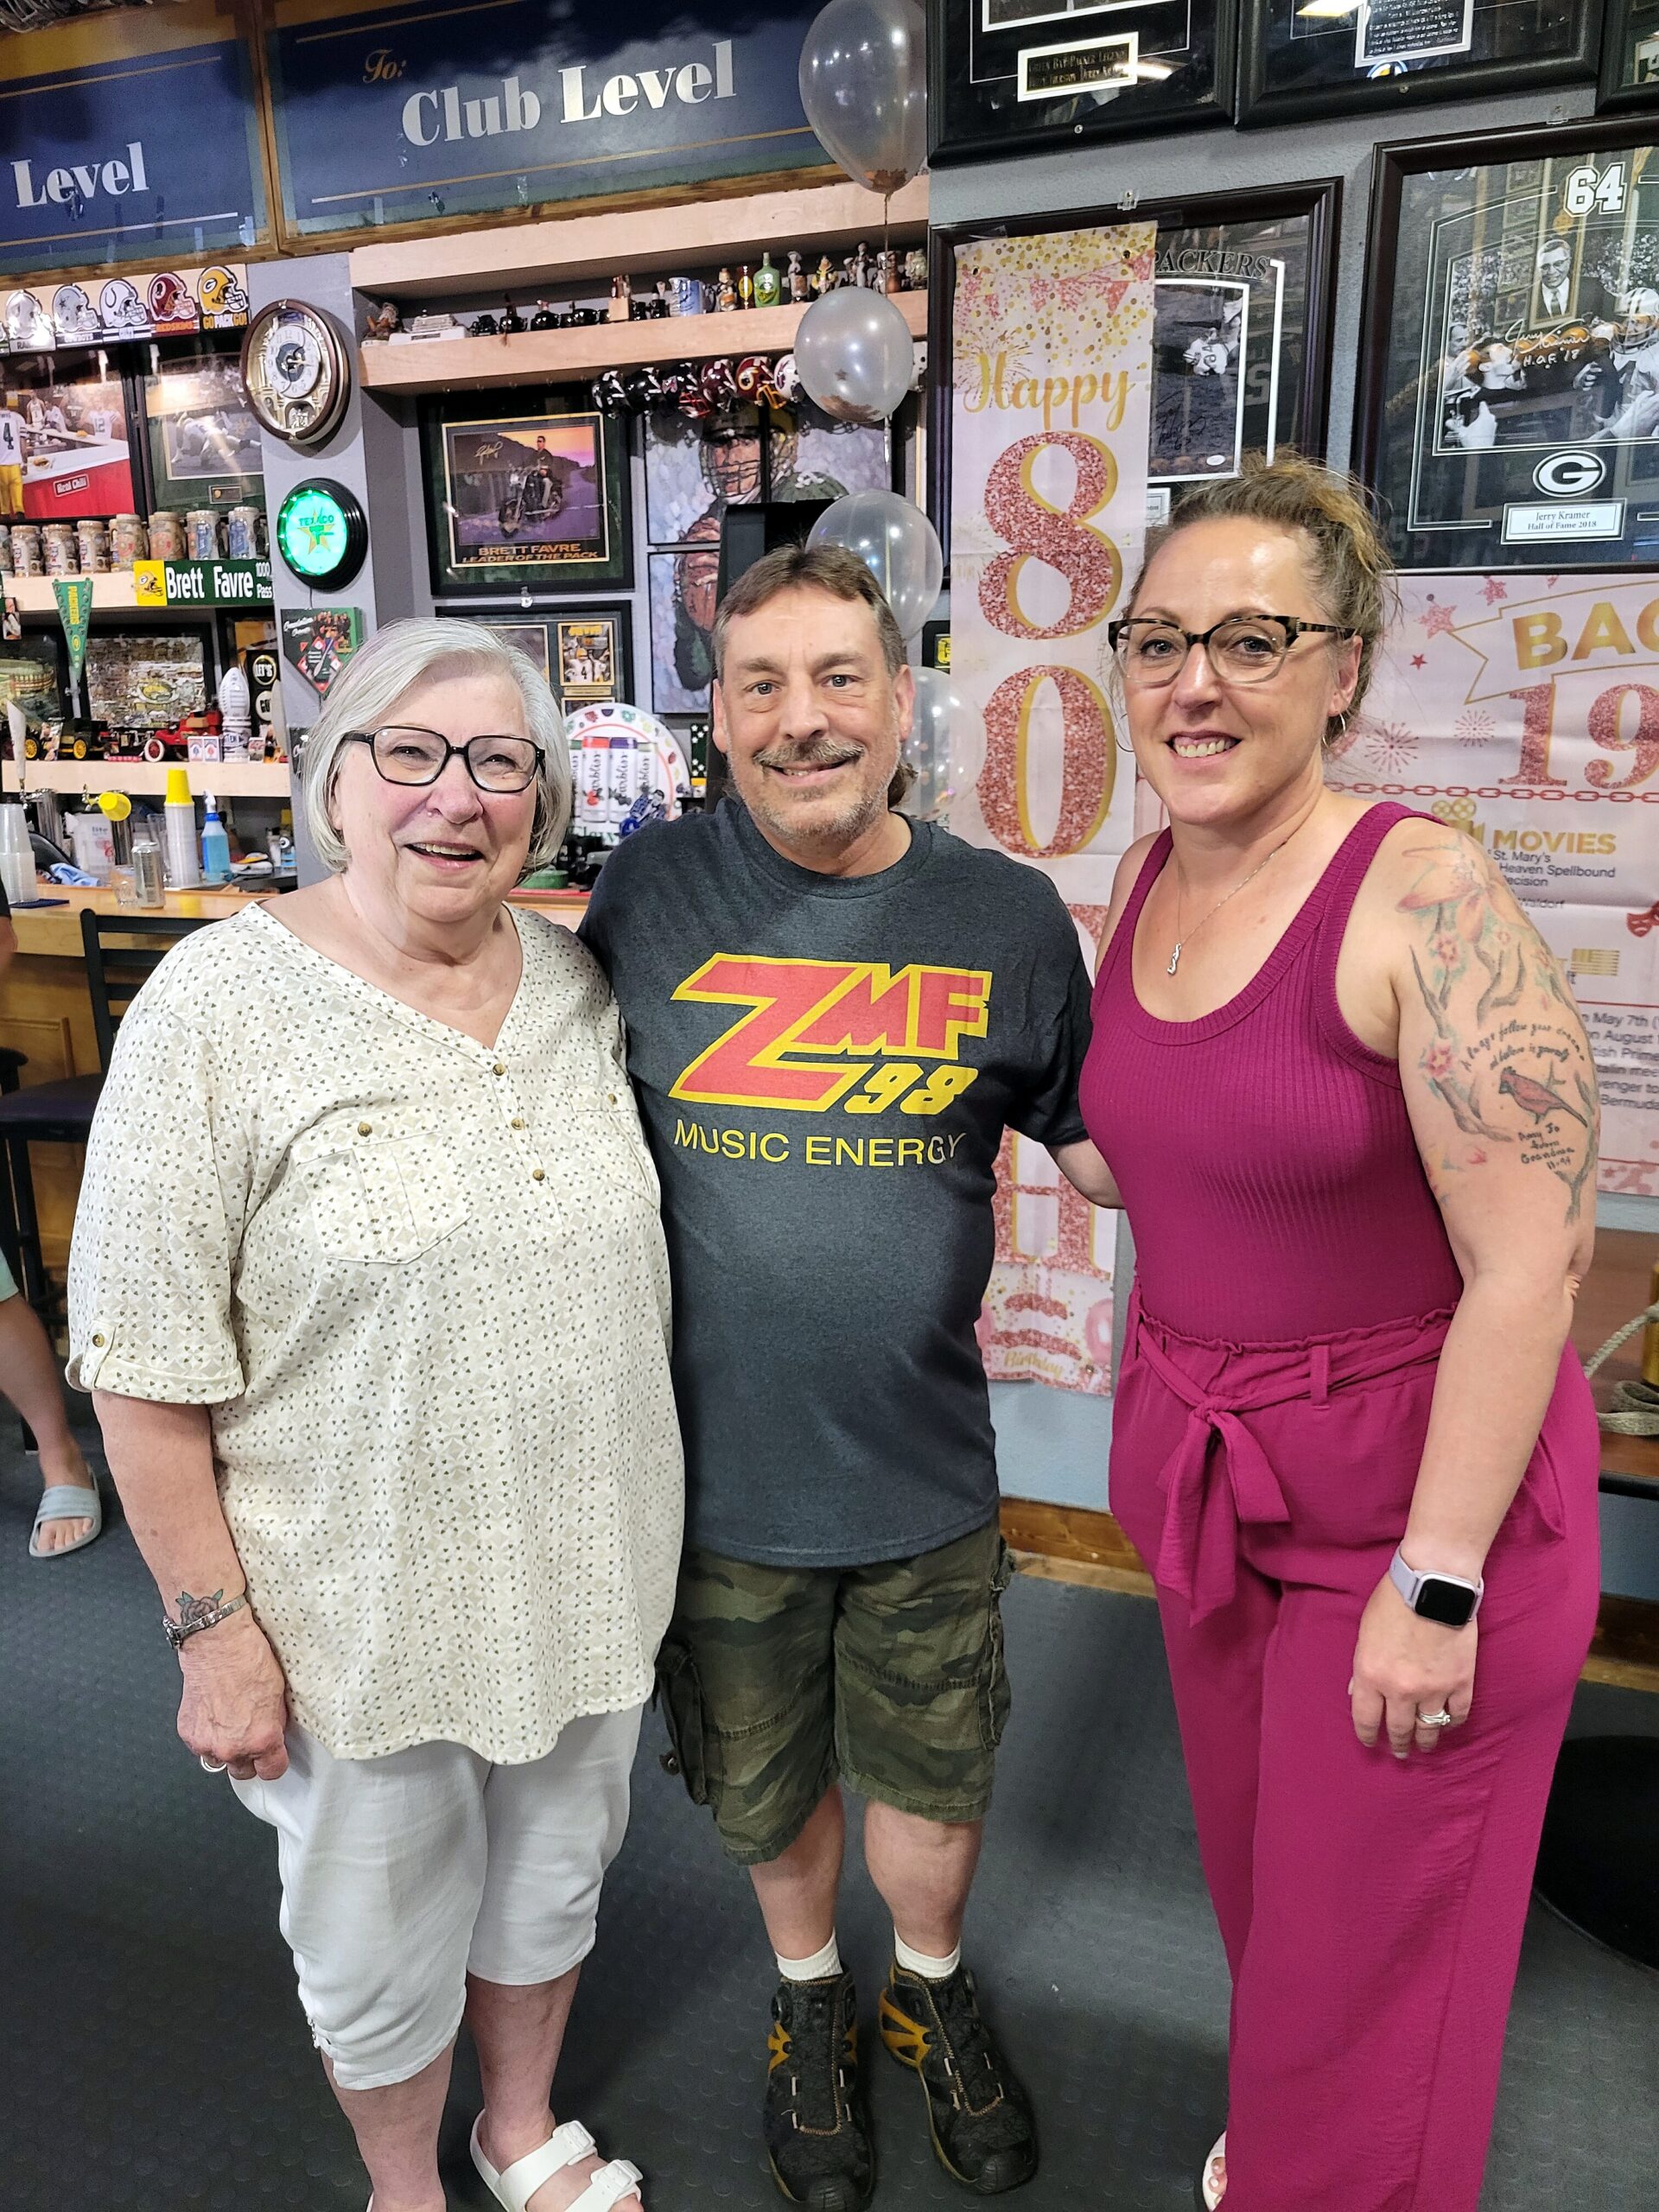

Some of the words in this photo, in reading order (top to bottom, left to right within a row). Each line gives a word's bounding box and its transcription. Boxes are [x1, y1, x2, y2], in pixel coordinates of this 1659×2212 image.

[361, 48, 407, 84] To:
[402, 76, 541, 147] Club
[557, 39, 737, 124] Level
[10, 142, 149, 207] Level
[1563, 162, 1627, 217] 64
[962, 350, 1137, 432] Happy
[1535, 512, 1556, 522] Jerry
[1558, 510, 1591, 519] Kramer
[1528, 522, 1543, 531] Hall
[1555, 521, 1577, 530] Fame
[1578, 520, 1597, 529] 2018
[462, 555, 514, 563] LEADER
[532, 552, 562, 561] THE
[563, 550, 598, 559] PACK
[479, 545, 529, 556] BRETT
[531, 543, 582, 554] FAVRE
[165, 566, 205, 599] Brett
[213, 565, 254, 598] Favre
[256, 583, 273, 599] Pass
[256, 664, 273, 677] LET'S
[1492, 829, 1617, 855] MOVIES
[1493, 849, 1509, 861] St.
[1511, 850, 1551, 865] Mary's
[1499, 862, 1543, 874] Heaven
[1547, 865, 1616, 878] Spellbound
[1592, 1012, 1624, 1027] May
[668, 951, 993, 1112] ZMF
[1603, 1029, 1653, 1045] August
[842, 1062, 979, 1115] 98
[674, 1118, 790, 1163] MUSIC
[805, 1132, 966, 1167] ENERGY
[1521, 1147, 1575, 1164] Grandma
